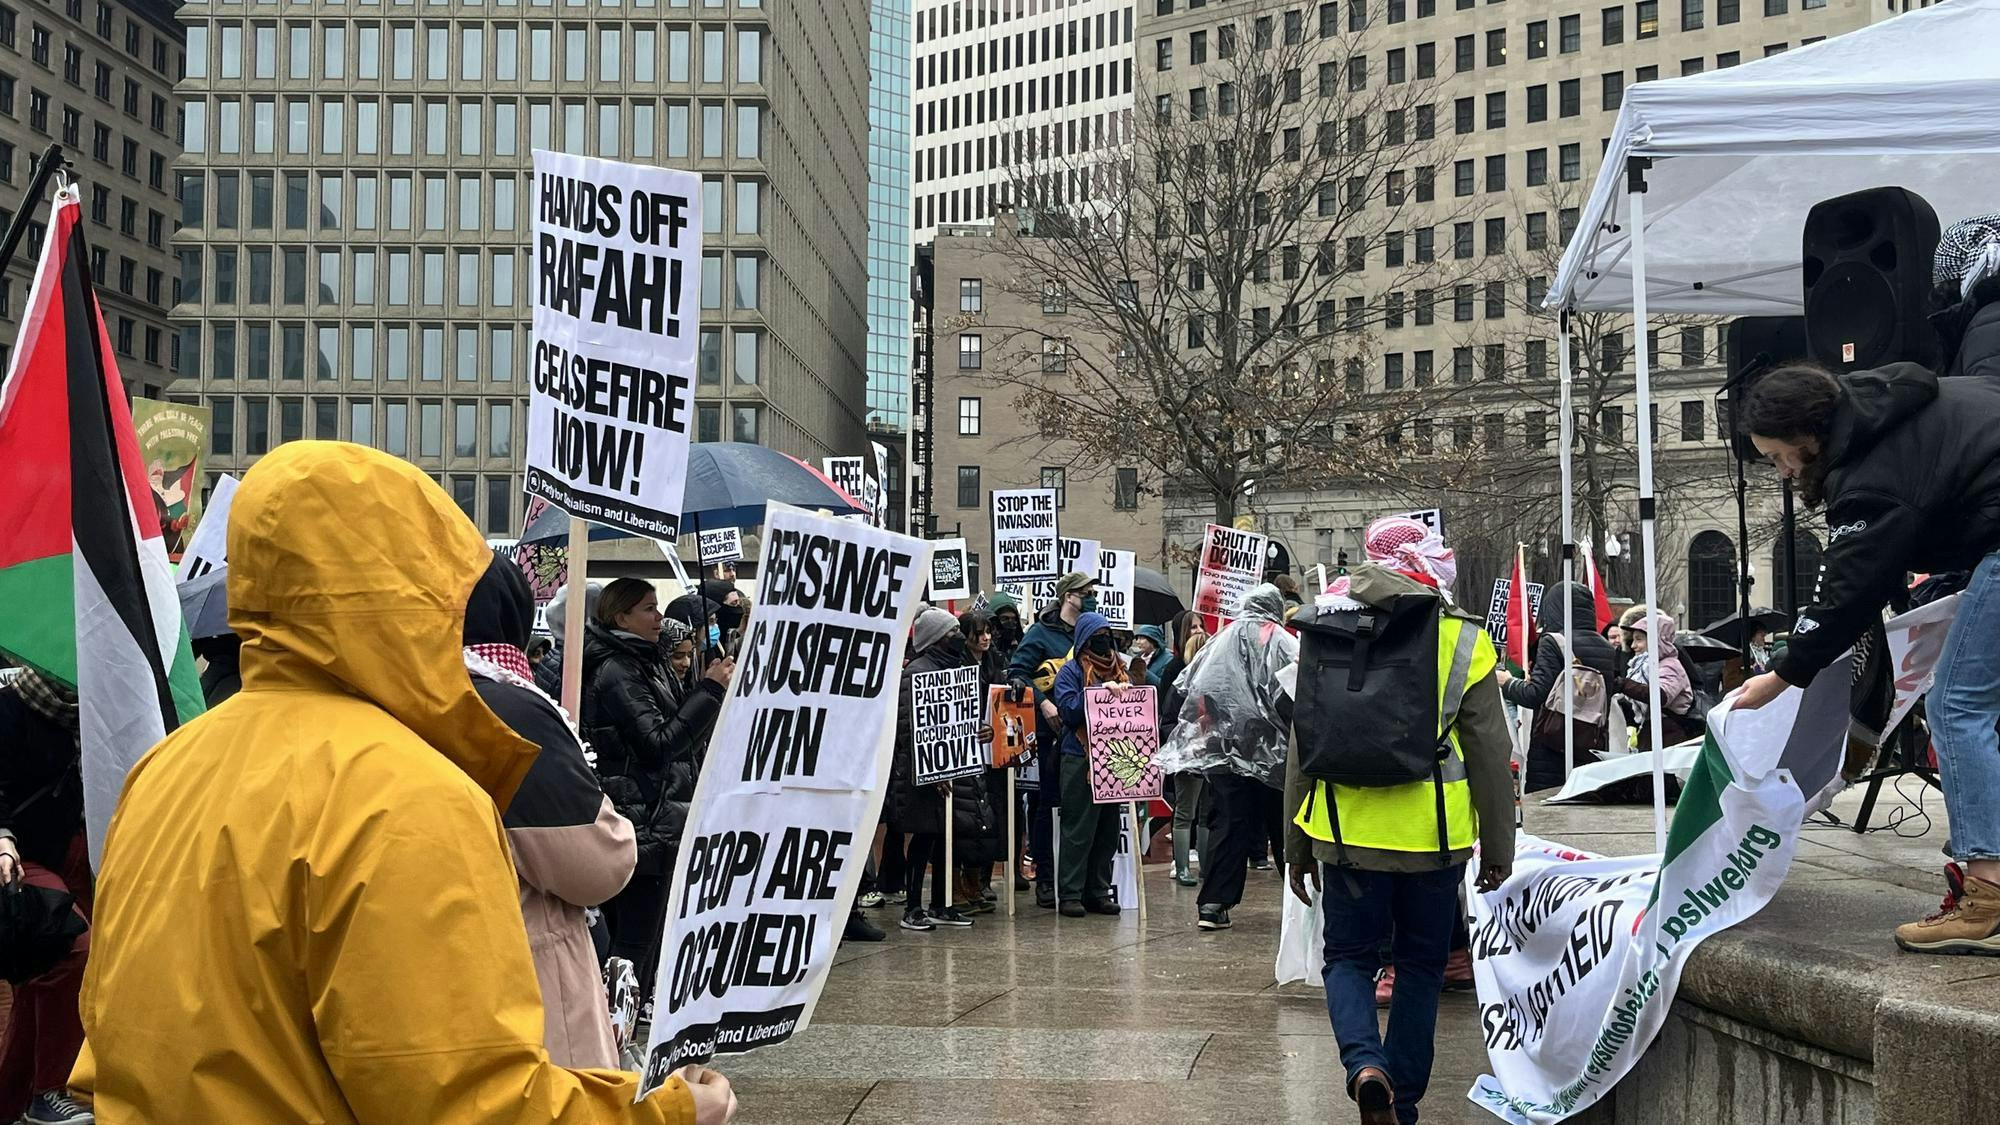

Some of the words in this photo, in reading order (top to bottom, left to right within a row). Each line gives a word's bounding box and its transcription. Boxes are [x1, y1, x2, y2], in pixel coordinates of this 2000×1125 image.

[540, 172, 622, 238] HANDS
[630, 189, 688, 248] OFF
[539, 231, 682, 338] RAFAH!
[534, 339, 688, 433] CEASEFIRE
[552, 407, 645, 496] NOW!
[831, 461, 861, 496] FREE
[997, 496, 1029, 512] STOP
[1030, 495, 1052, 511] THE
[604, 508, 623, 520] and
[624, 511, 675, 537] Liberation
[997, 513, 1053, 530] INVASION!
[700, 532, 722, 545] PEOPLE
[723, 530, 737, 541] ARE
[998, 539, 1034, 554] HANDS
[1036, 538, 1053, 552] OFF
[1060, 540, 1081, 559] ND
[1212, 529, 1246, 551] SHUT
[1248, 536, 1260, 553] IT
[1003, 553, 1050, 573] RAFAH!
[1099, 551, 1117, 569] ND
[1209, 545, 1258, 572] DOWN!
[1103, 590, 1125, 606] AID
[1098, 607, 1125, 620] RAEL!
[1211, 606, 1232, 617] FRE
[914, 671, 951, 690] STAND
[953, 666, 978, 684] WITH
[915, 682, 978, 706] PALESTINE!
[916, 703, 950, 728] END
[953, 697, 979, 722] THE
[1098, 705, 1144, 719] NEVER
[915, 720, 977, 744] OCCUPATION
[1092, 720, 1122, 736] Look
[917, 735, 978, 775] NOW!
[1098, 790, 1122, 798] GAZA
[1125, 789, 1141, 797] WILL
[762, 826, 853, 900] ARE
[717, 1025, 745, 1044] and
[746, 1017, 796, 1043] Liberation
